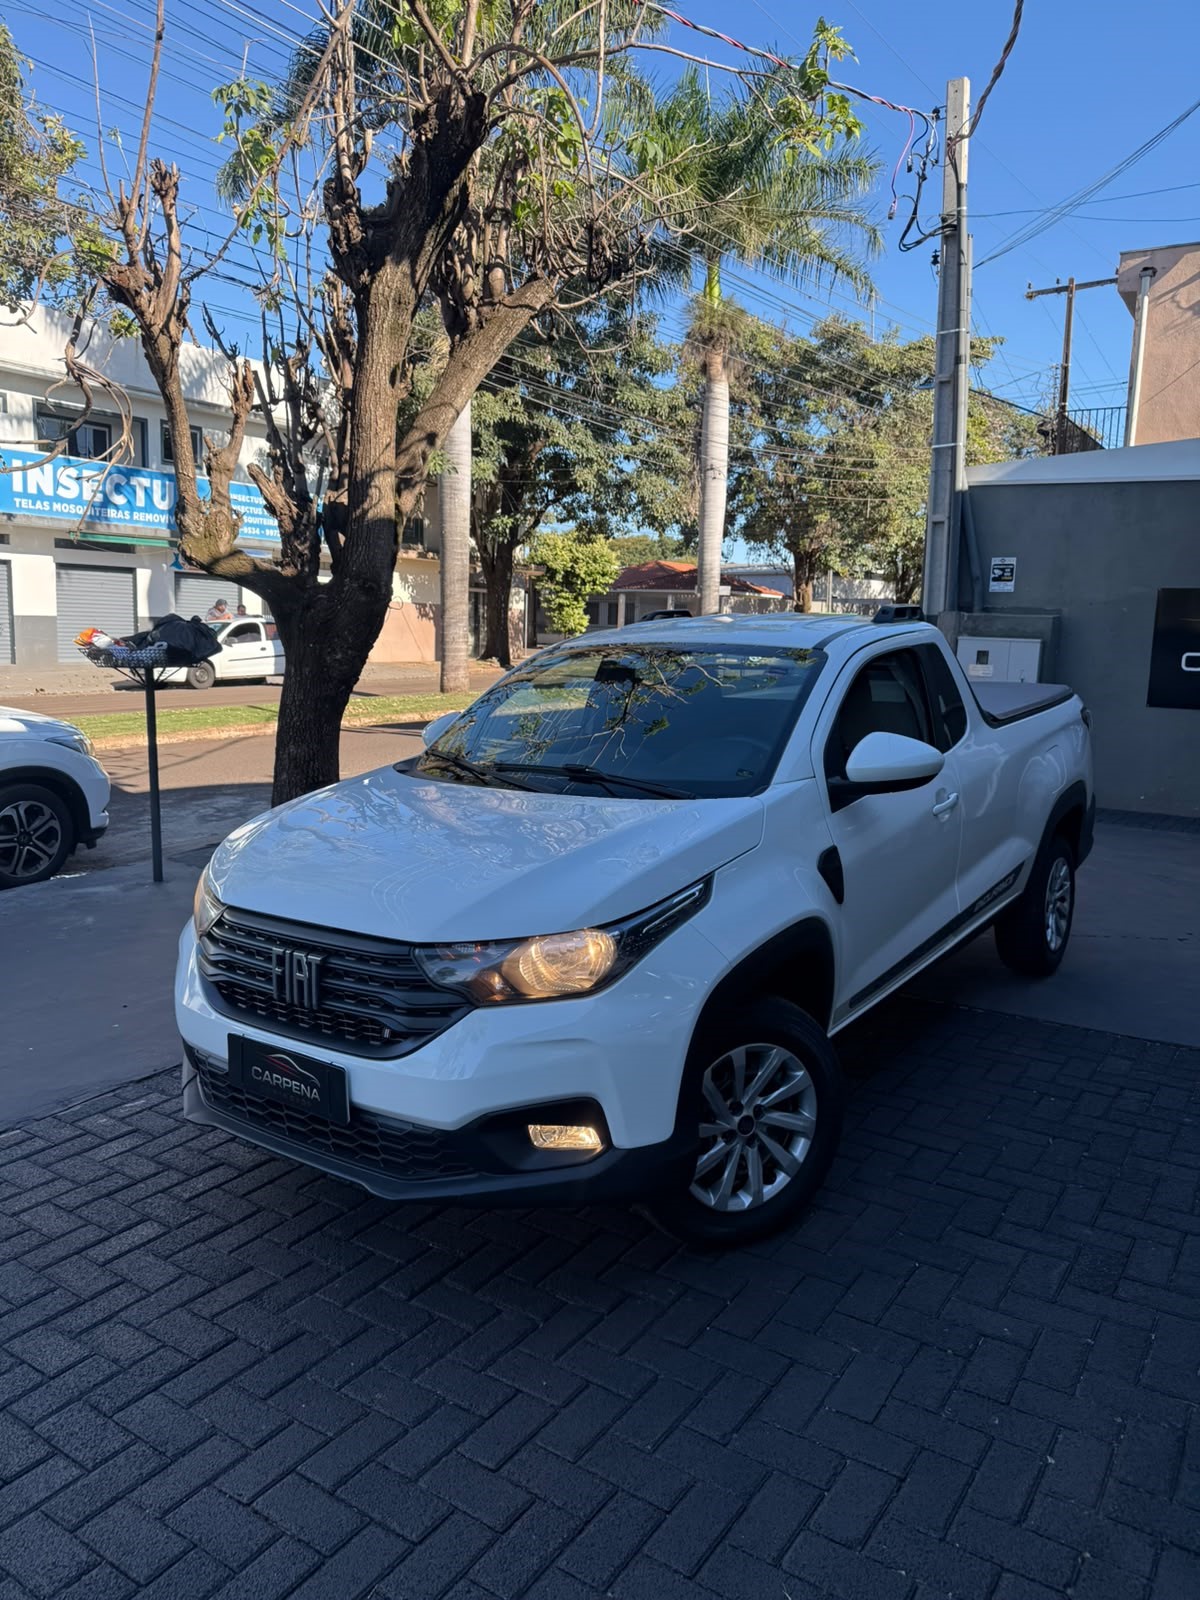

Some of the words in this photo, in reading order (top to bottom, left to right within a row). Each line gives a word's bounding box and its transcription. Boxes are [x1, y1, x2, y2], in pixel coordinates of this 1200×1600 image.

[12, 458, 175, 511] INSECTU
[13, 497, 50, 511] TELAS
[271, 946, 322, 1010] FIAT
[251, 1065, 321, 1102] CARPENA
